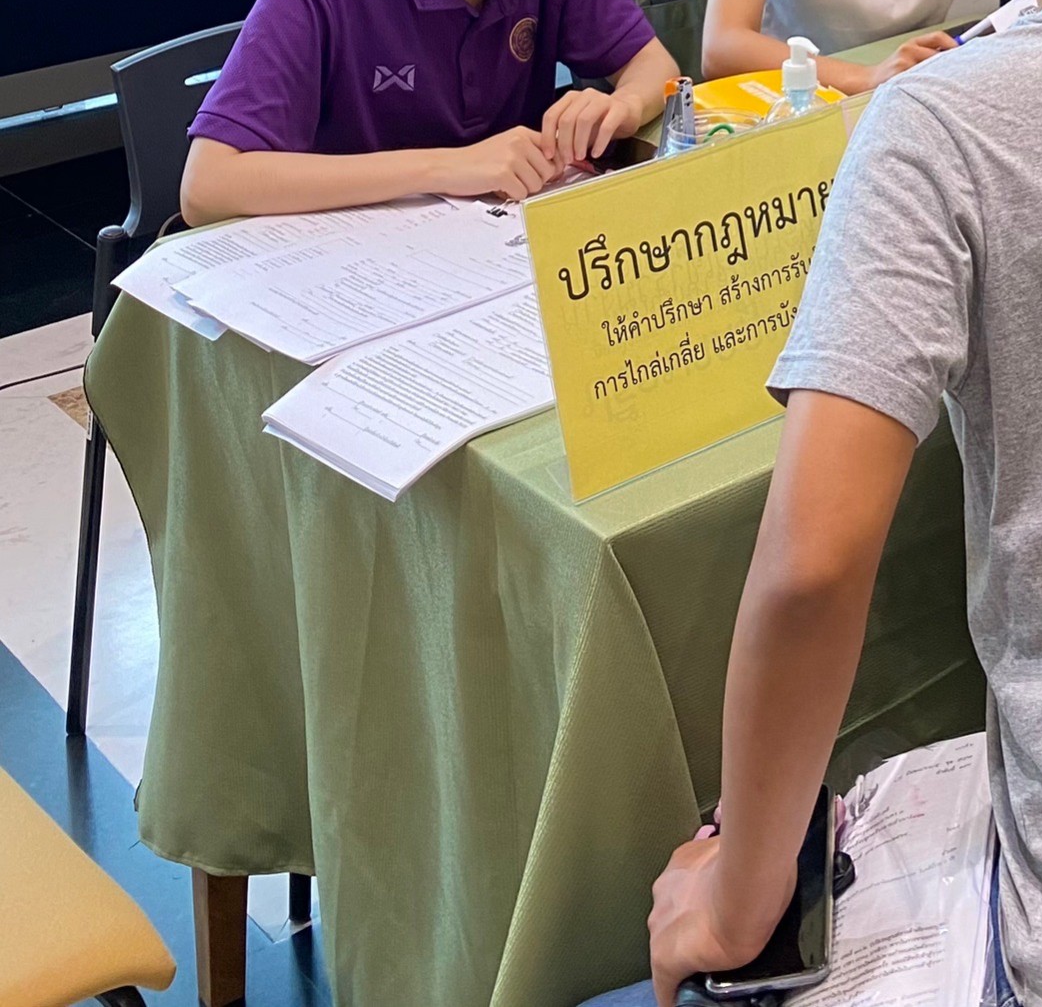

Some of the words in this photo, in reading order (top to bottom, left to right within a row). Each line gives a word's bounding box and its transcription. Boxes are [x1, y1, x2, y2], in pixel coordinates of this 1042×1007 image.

[601, 297, 713, 347] ให้คำปรึกษา
[594, 332, 705, 399] การไกล่เกลี่ย
